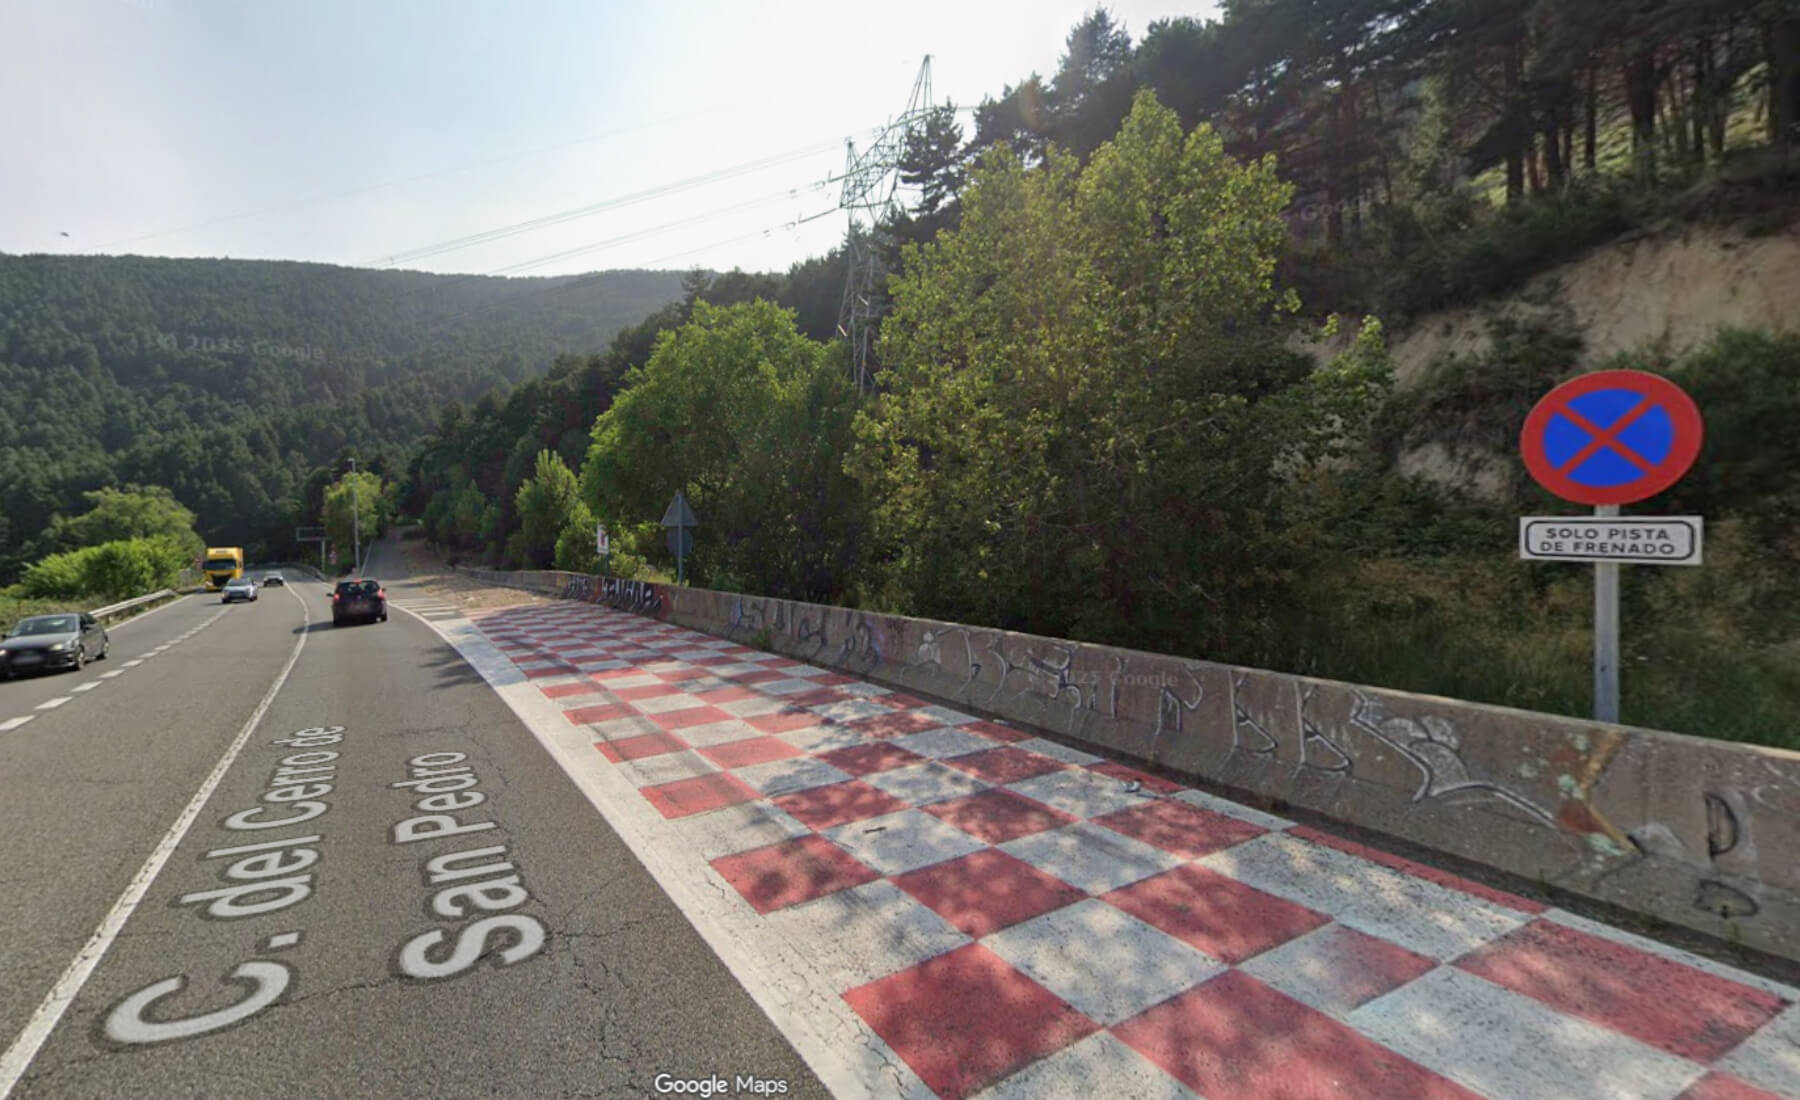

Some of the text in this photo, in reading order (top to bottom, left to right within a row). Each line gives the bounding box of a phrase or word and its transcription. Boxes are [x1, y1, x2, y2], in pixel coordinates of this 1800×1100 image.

[1546, 528, 1670, 541] SOLO PISTA
[1540, 541, 1675, 555] DE FRENADO
